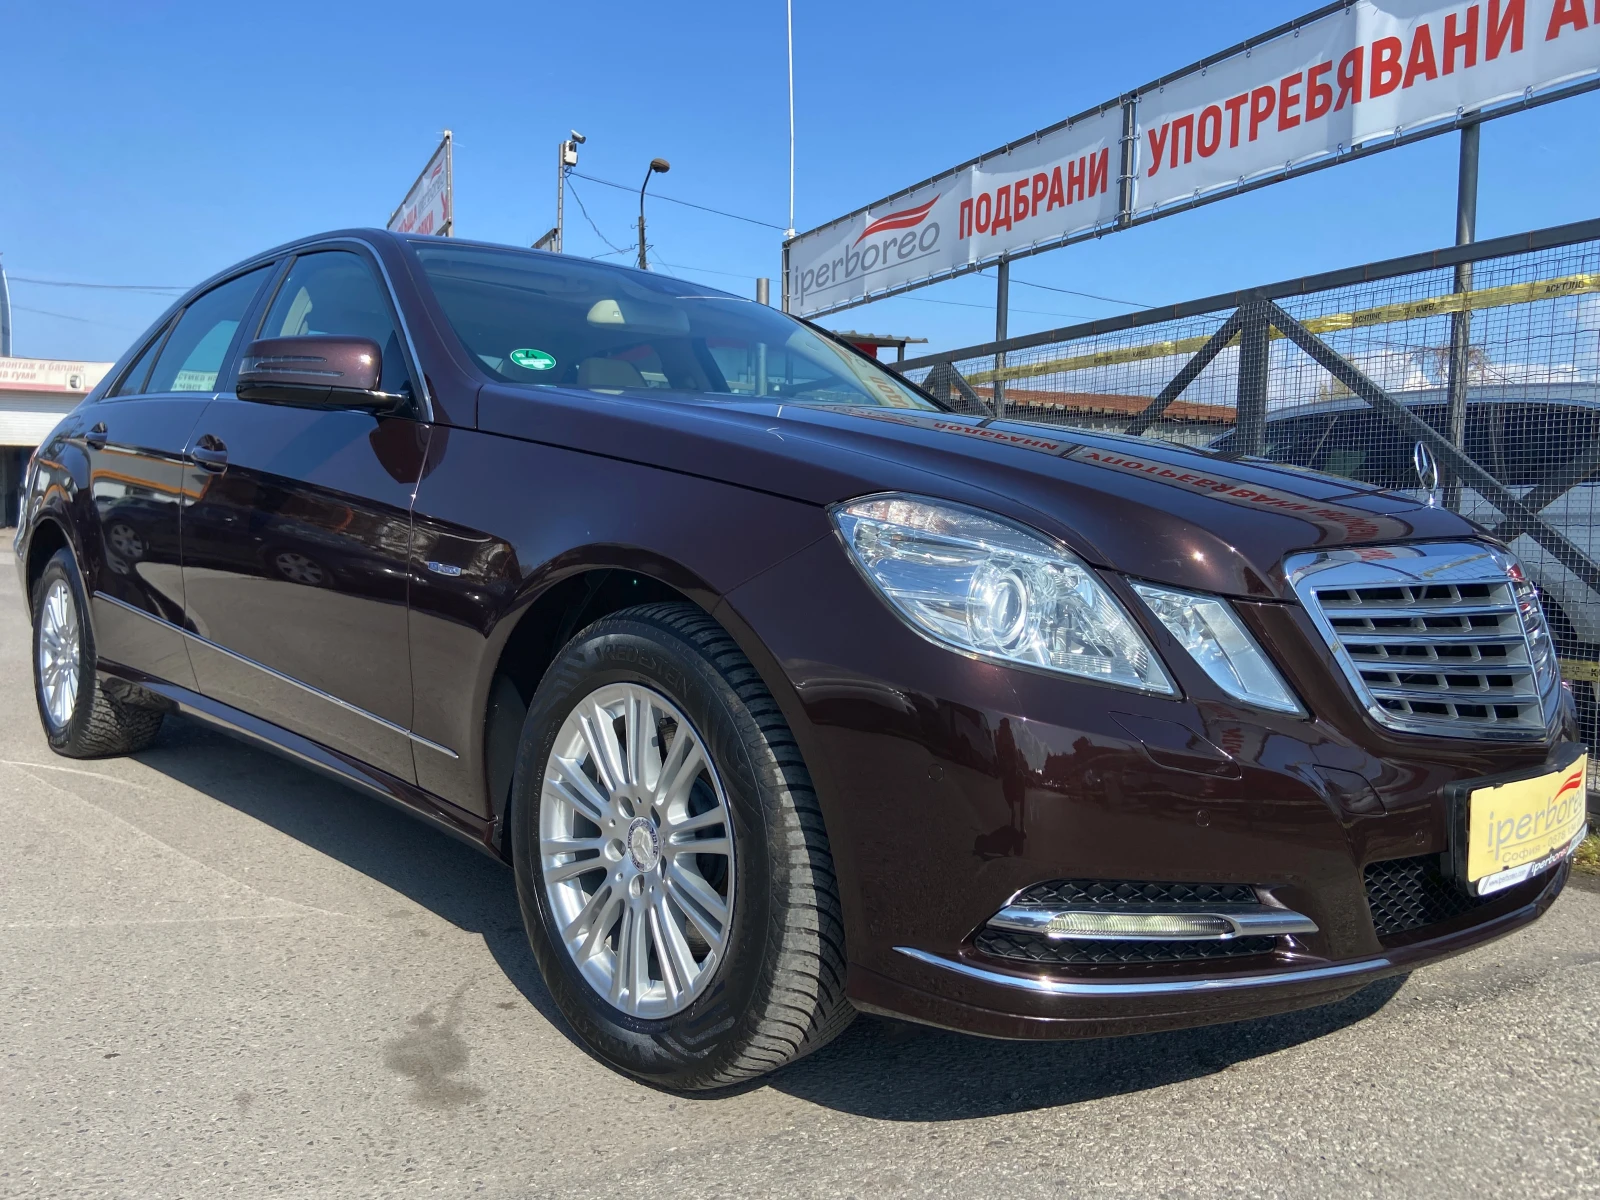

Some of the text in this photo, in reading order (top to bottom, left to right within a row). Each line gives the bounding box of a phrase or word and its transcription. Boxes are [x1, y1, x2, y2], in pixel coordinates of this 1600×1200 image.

[959, 148, 1109, 240] ПОДБРАНИ
[1147, 0, 1525, 178] УПОТРЕБЯВАНИ
[794, 222, 940, 306] iperboreo
